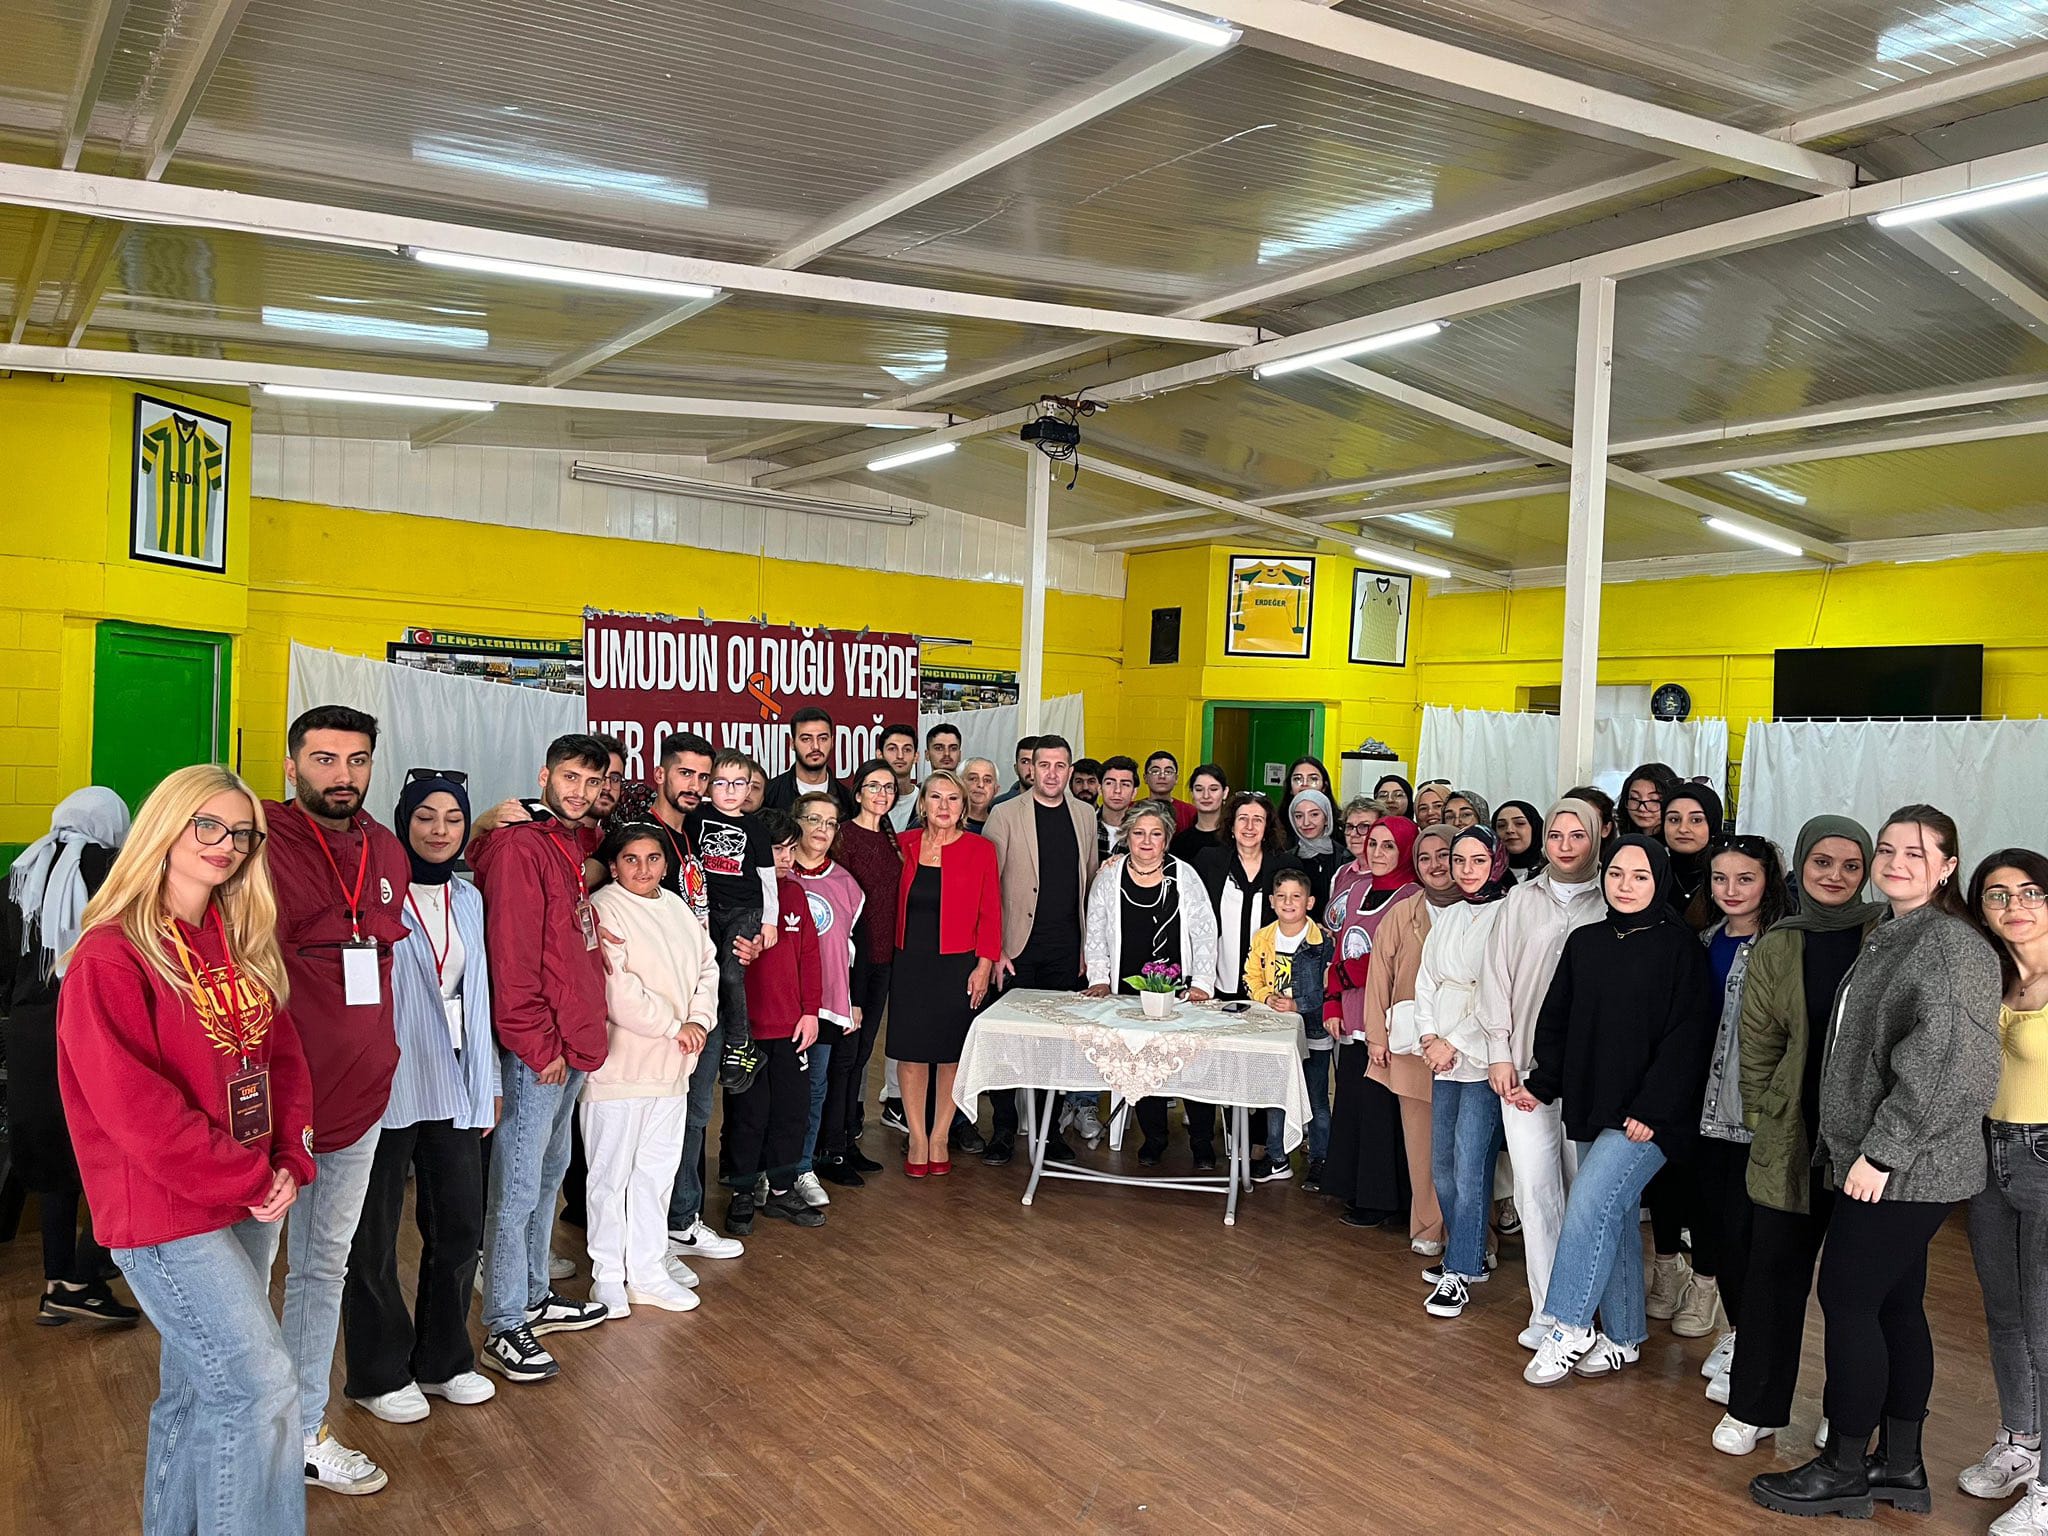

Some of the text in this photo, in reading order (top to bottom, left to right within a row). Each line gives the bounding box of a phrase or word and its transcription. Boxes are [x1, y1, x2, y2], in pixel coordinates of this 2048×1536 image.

[587, 626, 917, 699] UMUDUN OLDUĞU YERDE
